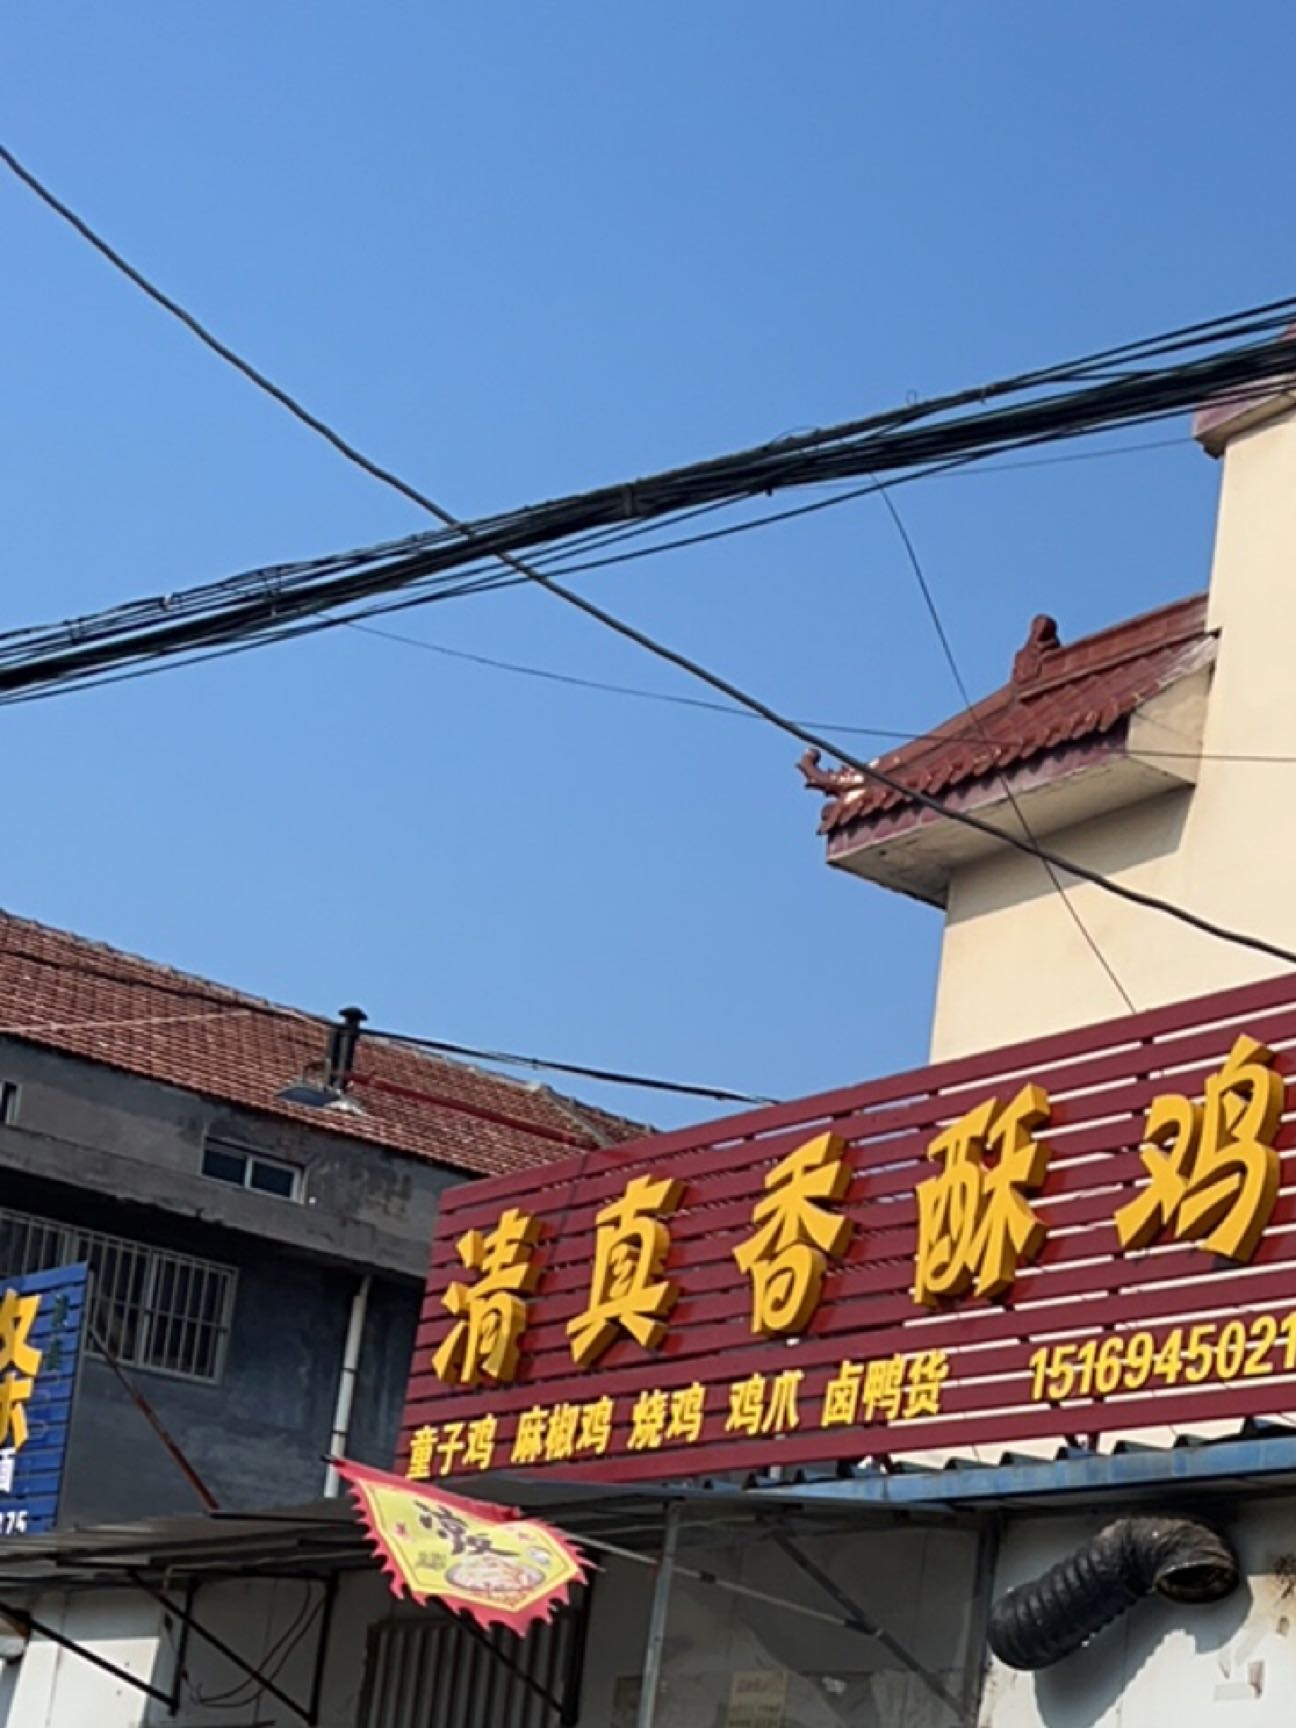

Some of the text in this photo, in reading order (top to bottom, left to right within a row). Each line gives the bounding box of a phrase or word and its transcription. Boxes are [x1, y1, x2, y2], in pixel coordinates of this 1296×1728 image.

[431, 1032, 1287, 1385] 清真香酥鸡
[404, 1411, 498, 1480] 童子鸡
[510, 1395, 615, 1464] 麻椒鸡
[626, 1380, 706, 1450] 烧鸡
[725, 1369, 805, 1434] 鸡爪
[820, 1350, 951, 1428] 卤鸭货
